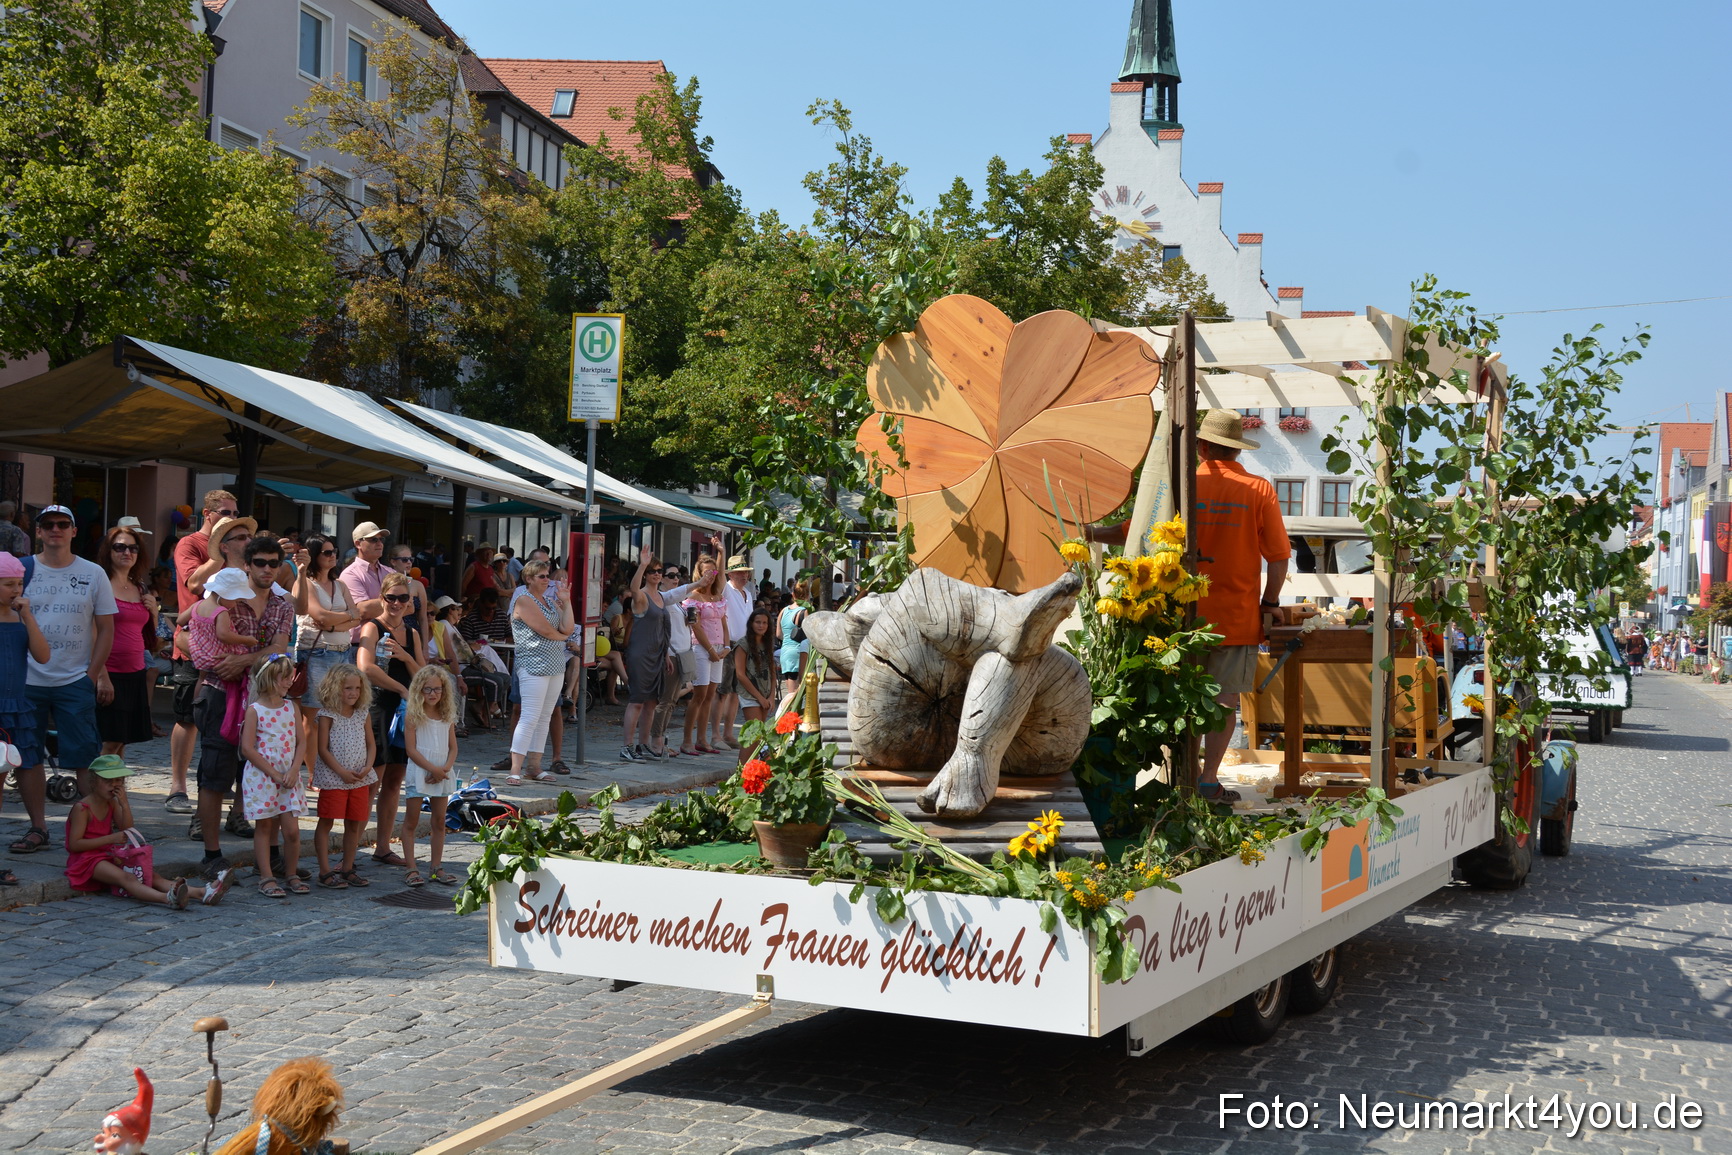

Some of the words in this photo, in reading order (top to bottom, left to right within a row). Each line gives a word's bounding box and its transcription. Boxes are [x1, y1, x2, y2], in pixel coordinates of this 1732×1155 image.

[588, 330, 607, 354] H
[580, 366, 612, 375] Marktplatz
[1444, 801, 1459, 850] 70
[514, 881, 641, 944] Schreiner
[649, 898, 752, 956] machen
[760, 903, 871, 970] Frauen
[880, 921, 1027, 993] glücklich
[1119, 914, 1163, 985] Da
[1170, 901, 1212, 973] lieg
[1219, 892, 1228, 939] i
[1234, 884, 1277, 954] gern
